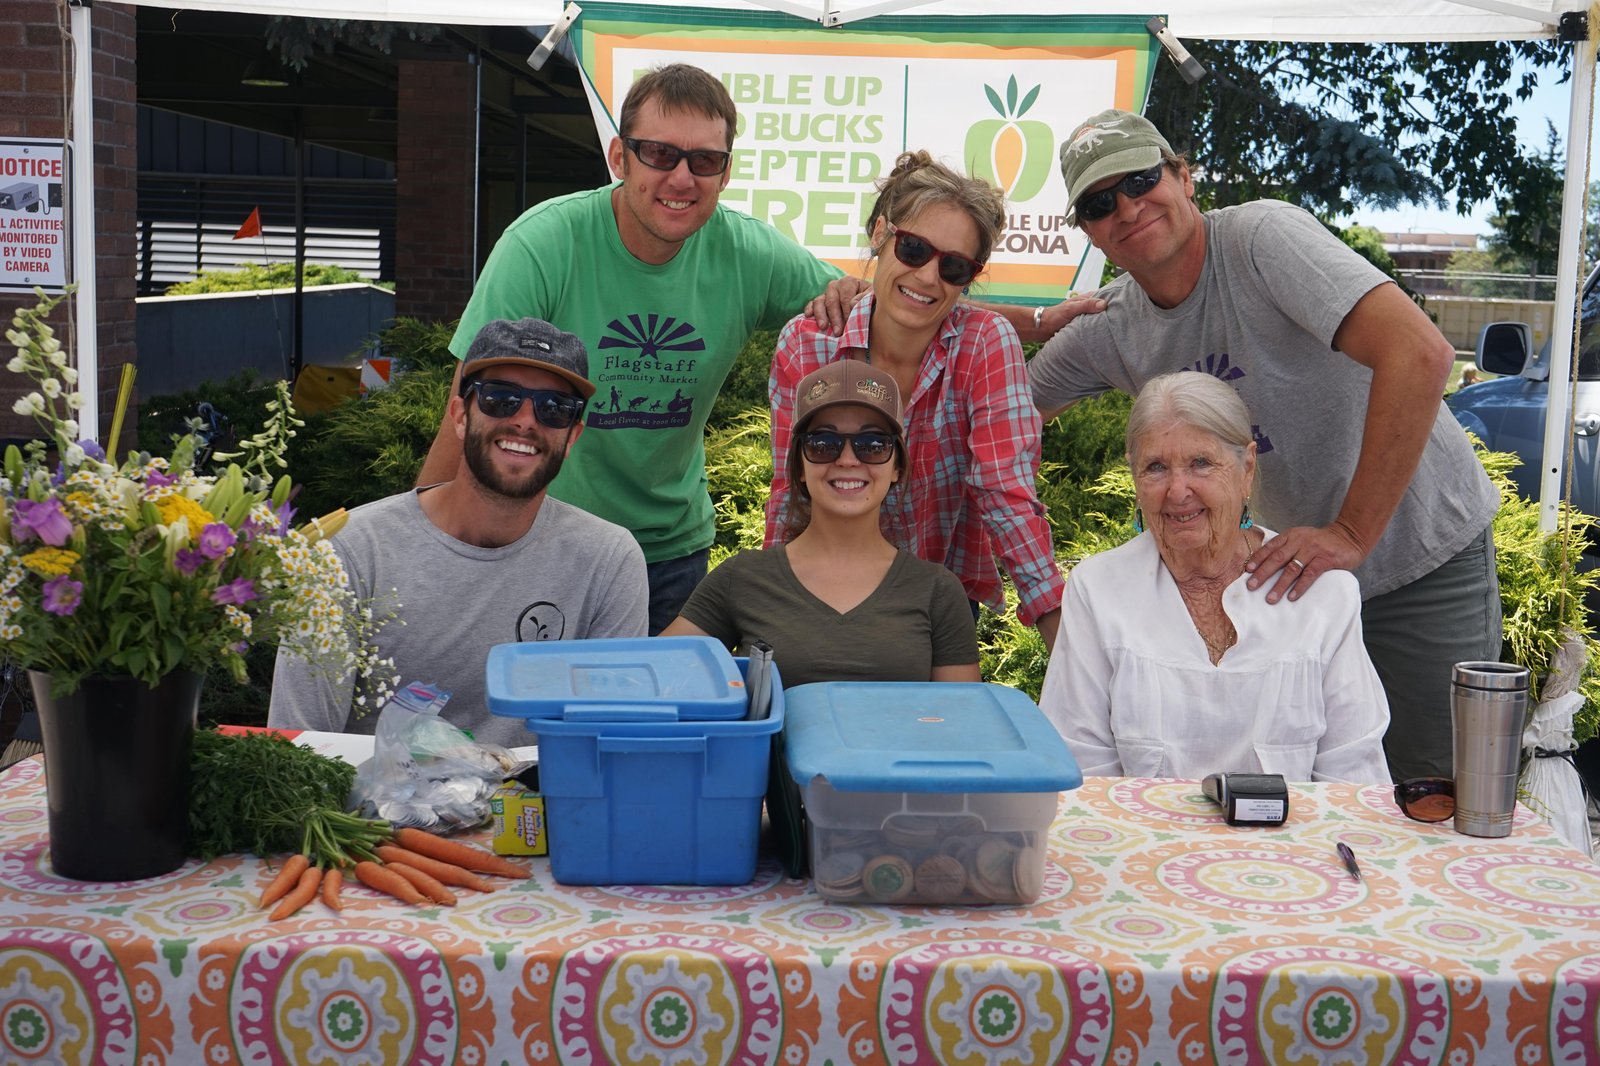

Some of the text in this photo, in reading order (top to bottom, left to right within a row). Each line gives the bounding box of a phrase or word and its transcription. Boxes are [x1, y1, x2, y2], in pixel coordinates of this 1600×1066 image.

[824, 75, 883, 106] UP
[754, 112, 884, 144] BUCKS
[730, 149, 882, 184] EPTED
[1038, 215, 1067, 232] UP
[0, 232, 58, 245] MONITORED
[991, 233, 1070, 255] ZONA
[3, 246, 52, 259] BY VIDEO
[5, 260, 50, 273] CAMERA
[604, 356, 696, 372] Flagstaff
[598, 373, 698, 384] Community Market
[495, 801, 503, 812] 150
[523, 806, 539, 846] basics
